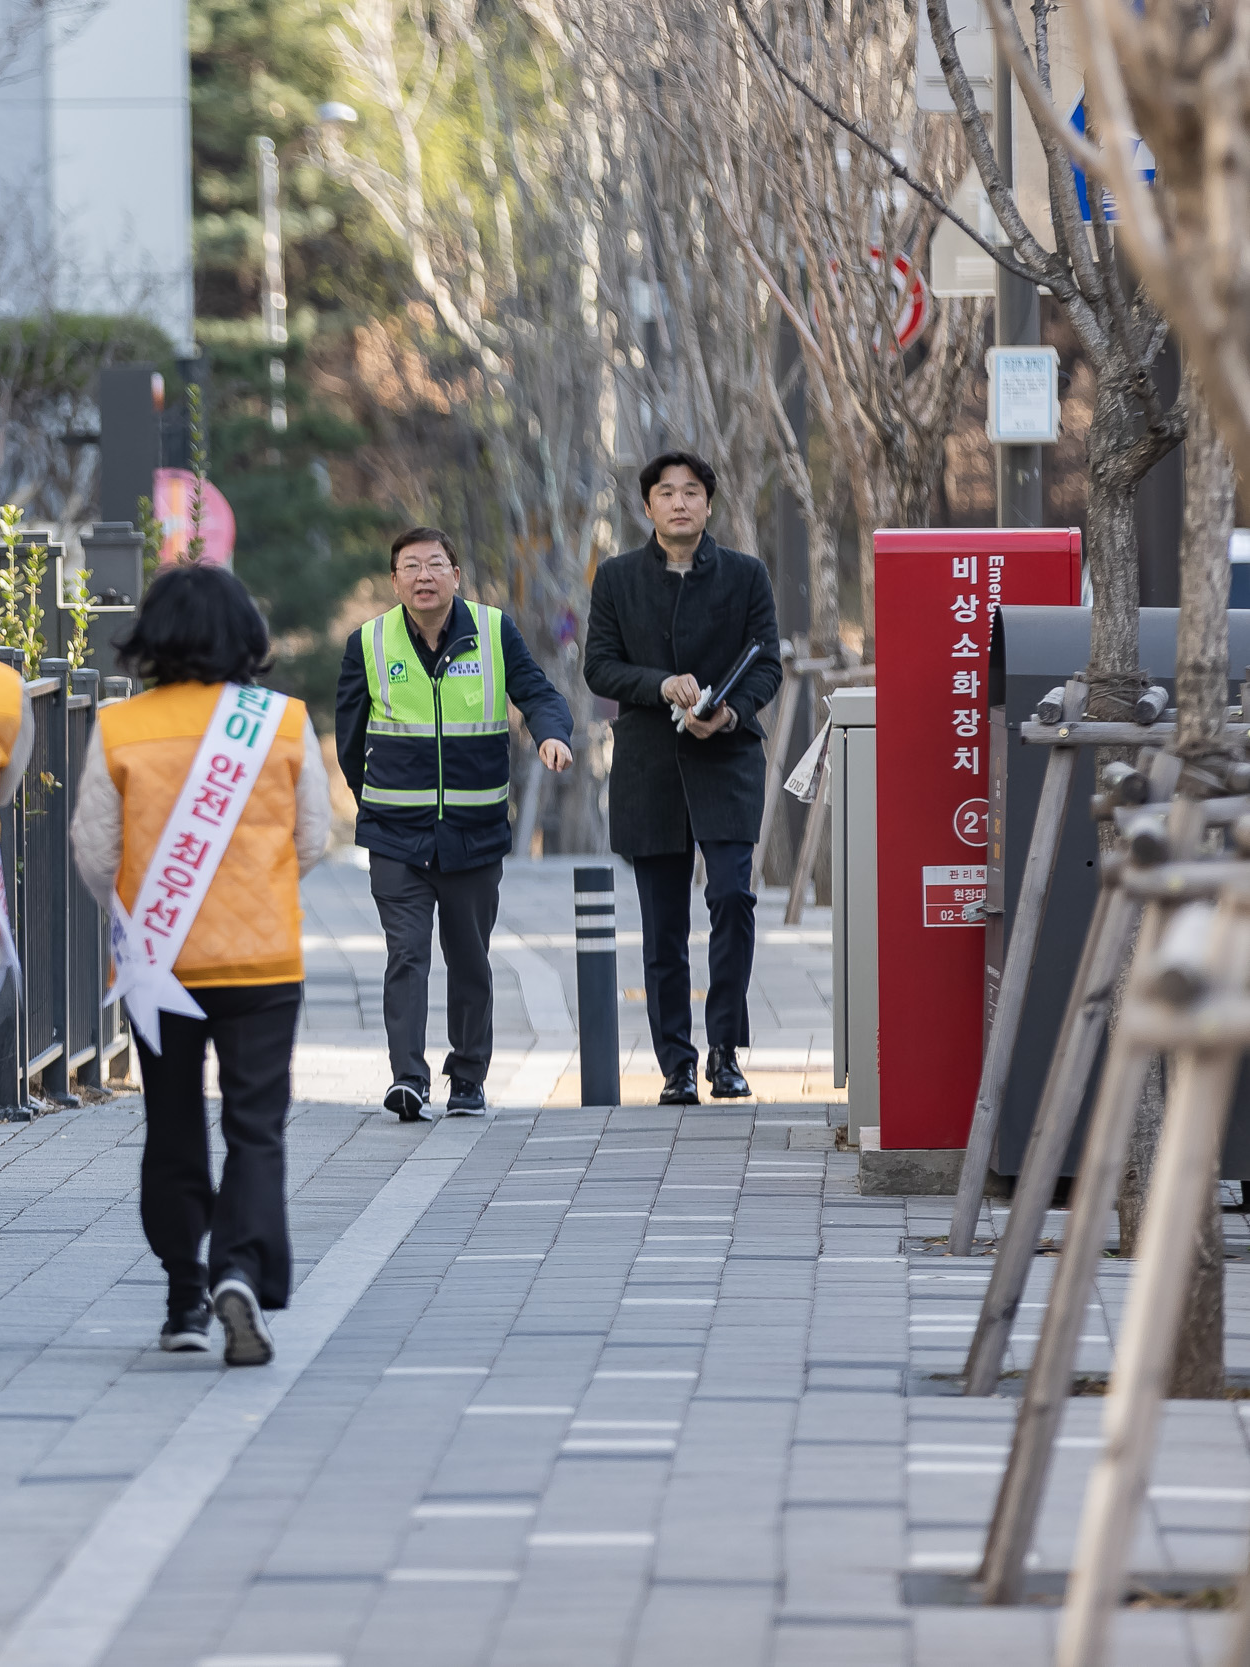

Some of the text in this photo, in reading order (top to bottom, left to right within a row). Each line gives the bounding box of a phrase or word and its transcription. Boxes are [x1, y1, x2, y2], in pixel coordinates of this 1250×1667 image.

[950, 555, 980, 774] 비상소화장치
[224, 684, 272, 748] 린이
[192, 753, 248, 828] 안전
[940, 909, 968, 922] 02-6
